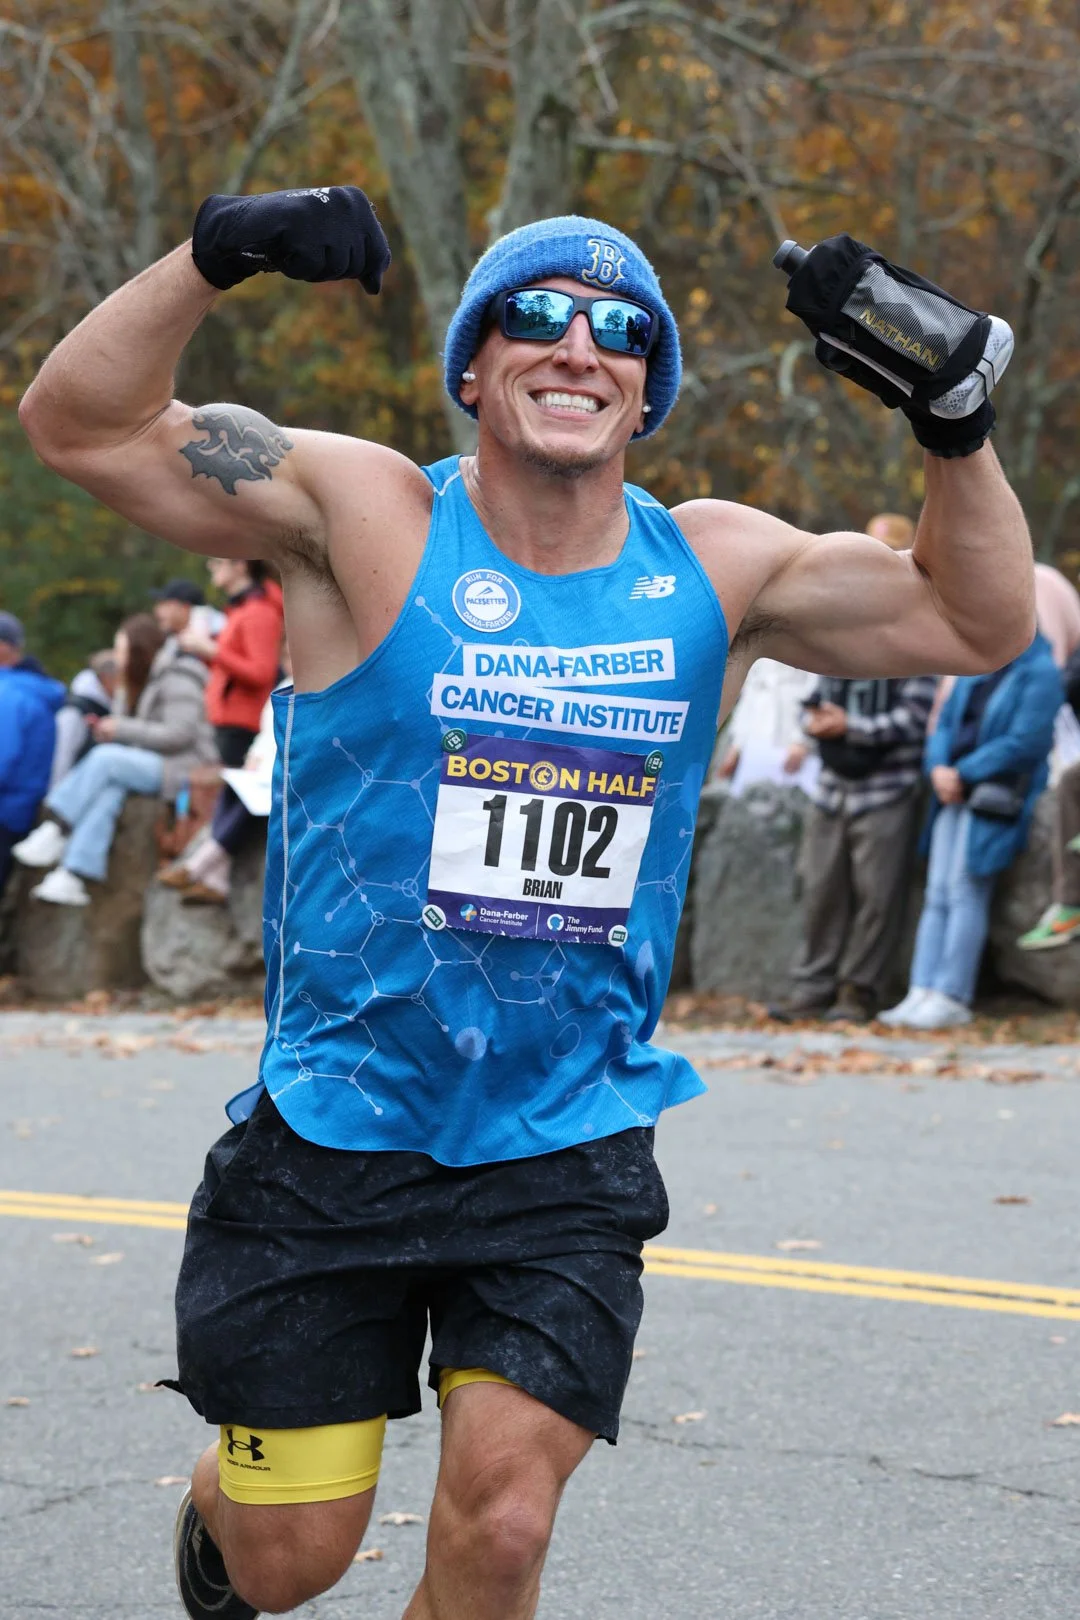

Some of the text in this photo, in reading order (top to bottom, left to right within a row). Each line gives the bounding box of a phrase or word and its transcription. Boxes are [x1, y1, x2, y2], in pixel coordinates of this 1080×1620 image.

[859, 308, 940, 367] NATHAN
[464, 573, 504, 584] RUN FOR
[466, 597, 507, 605] PACESETTER
[463, 610, 514, 628] DANA-FARBER
[475, 649, 665, 678] DANA-FARBER
[440, 685, 683, 735] CANCER INSTITUTE
[587, 771, 657, 798] HALF
[482, 794, 619, 879] 1102
[522, 878, 563, 899] BRIAN
[479, 916, 523, 927] Cancer Institute
[480, 907, 529, 921] Dana-Farber
[567, 916, 580, 924] The
[565, 925, 587, 934] Jimmy
[240, 1463, 271, 1471] ARMOUR
